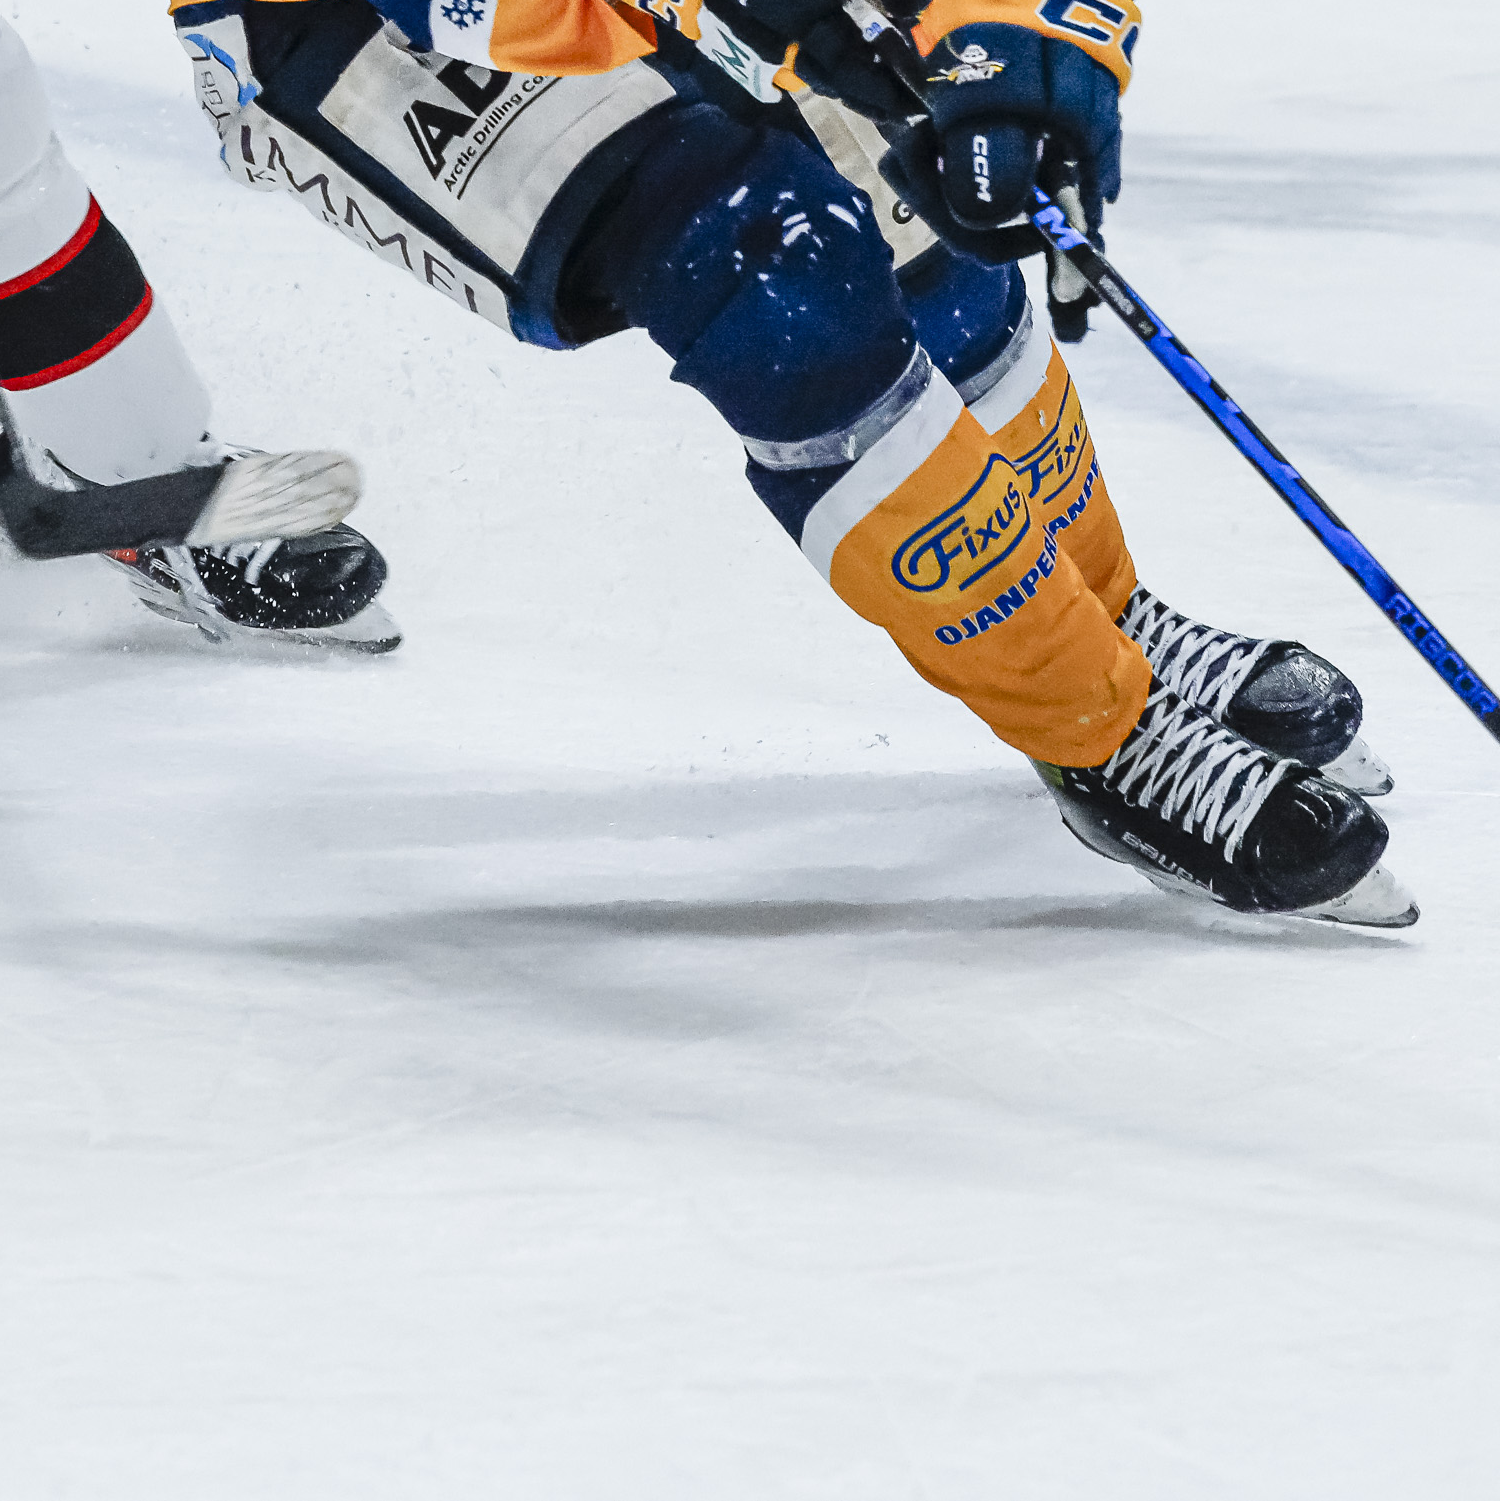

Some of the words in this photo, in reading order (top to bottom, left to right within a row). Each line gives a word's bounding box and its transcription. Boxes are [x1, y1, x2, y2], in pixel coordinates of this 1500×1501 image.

[443, 145, 477, 193] Arctic
[472, 92, 523, 146] Drilling
[972, 134, 992, 203] CCM
[900, 480, 1021, 589] Fixus
